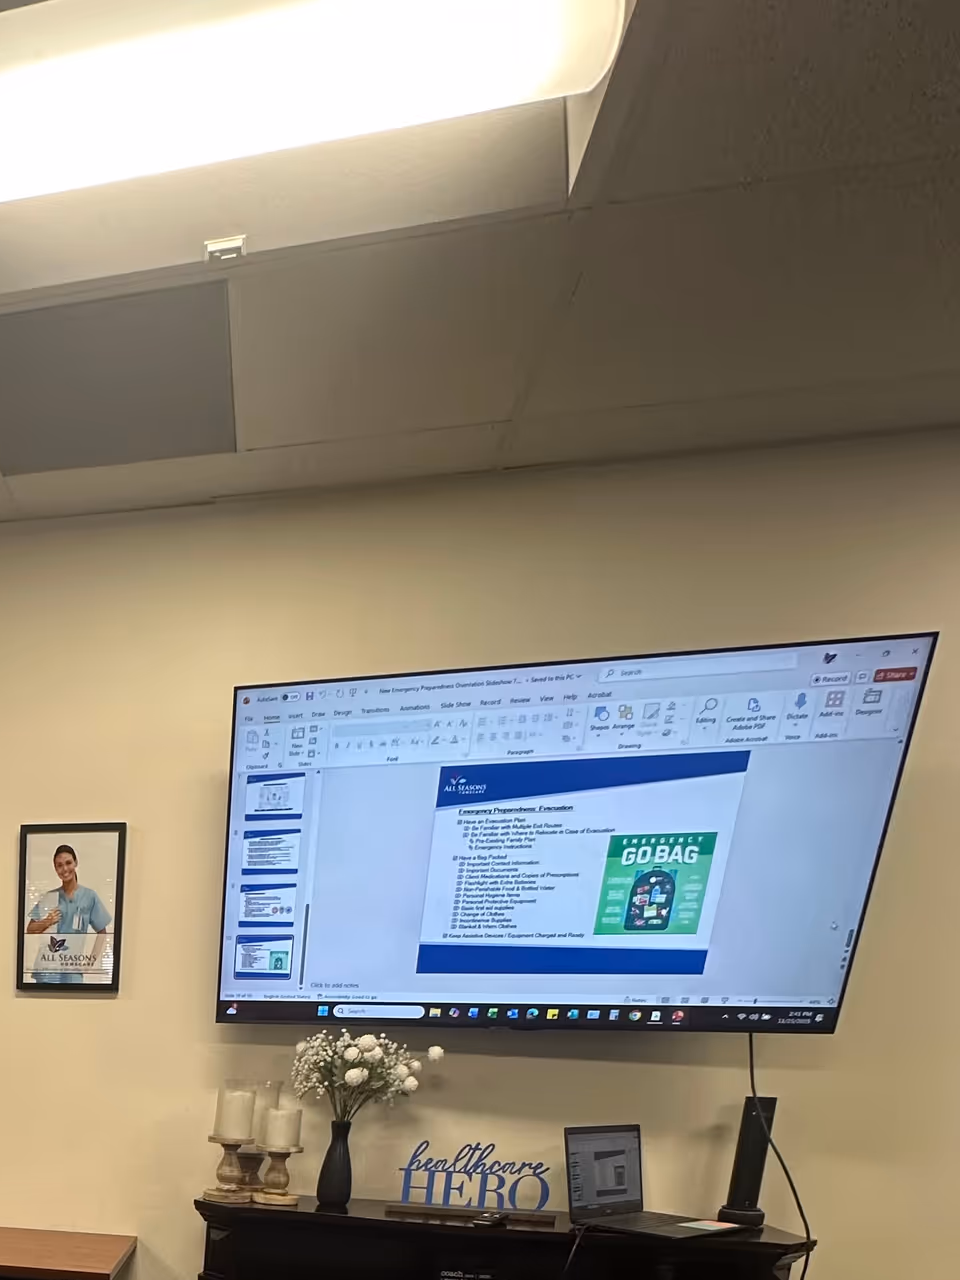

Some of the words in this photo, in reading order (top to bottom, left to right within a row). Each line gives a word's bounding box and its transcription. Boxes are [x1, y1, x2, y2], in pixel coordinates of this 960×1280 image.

[823, 674, 848, 684] Record
[333, 709, 352, 717] Design
[361, 707, 390, 715] Transitions
[400, 704, 430, 712] Animations
[440, 701, 456, 709] Slide
[480, 698, 501, 706] Record
[564, 693, 577, 701] Help
[458, 784, 486, 792] SEASONS
[623, 836, 704, 844] EMERGENCY
[621, 846, 652, 866] GO
[654, 845, 699, 863] BAG
[59, 953, 96, 961] SEASONS
[407, 1140, 550, 1174] healthcare
[399, 1168, 550, 1211] HERO
